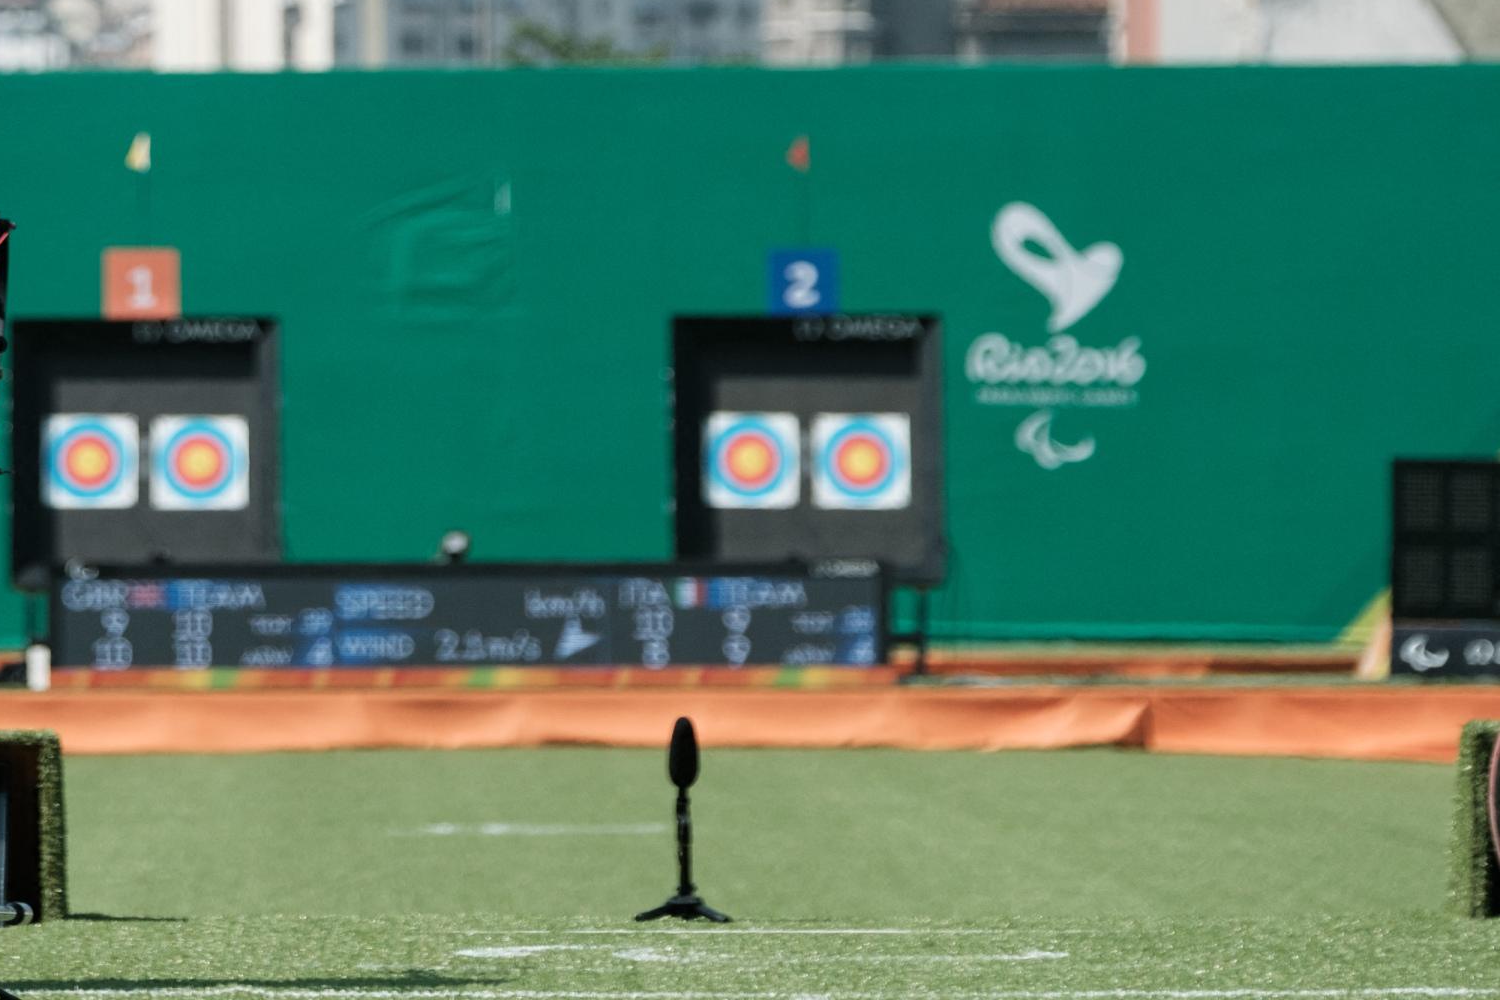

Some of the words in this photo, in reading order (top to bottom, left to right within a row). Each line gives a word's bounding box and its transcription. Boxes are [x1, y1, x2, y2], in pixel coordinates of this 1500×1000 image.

[126, 265, 157, 310] 1
[782, 261, 820, 309] 2
[335, 587, 434, 620] SPEED
[337, 633, 415, 661] WIND
